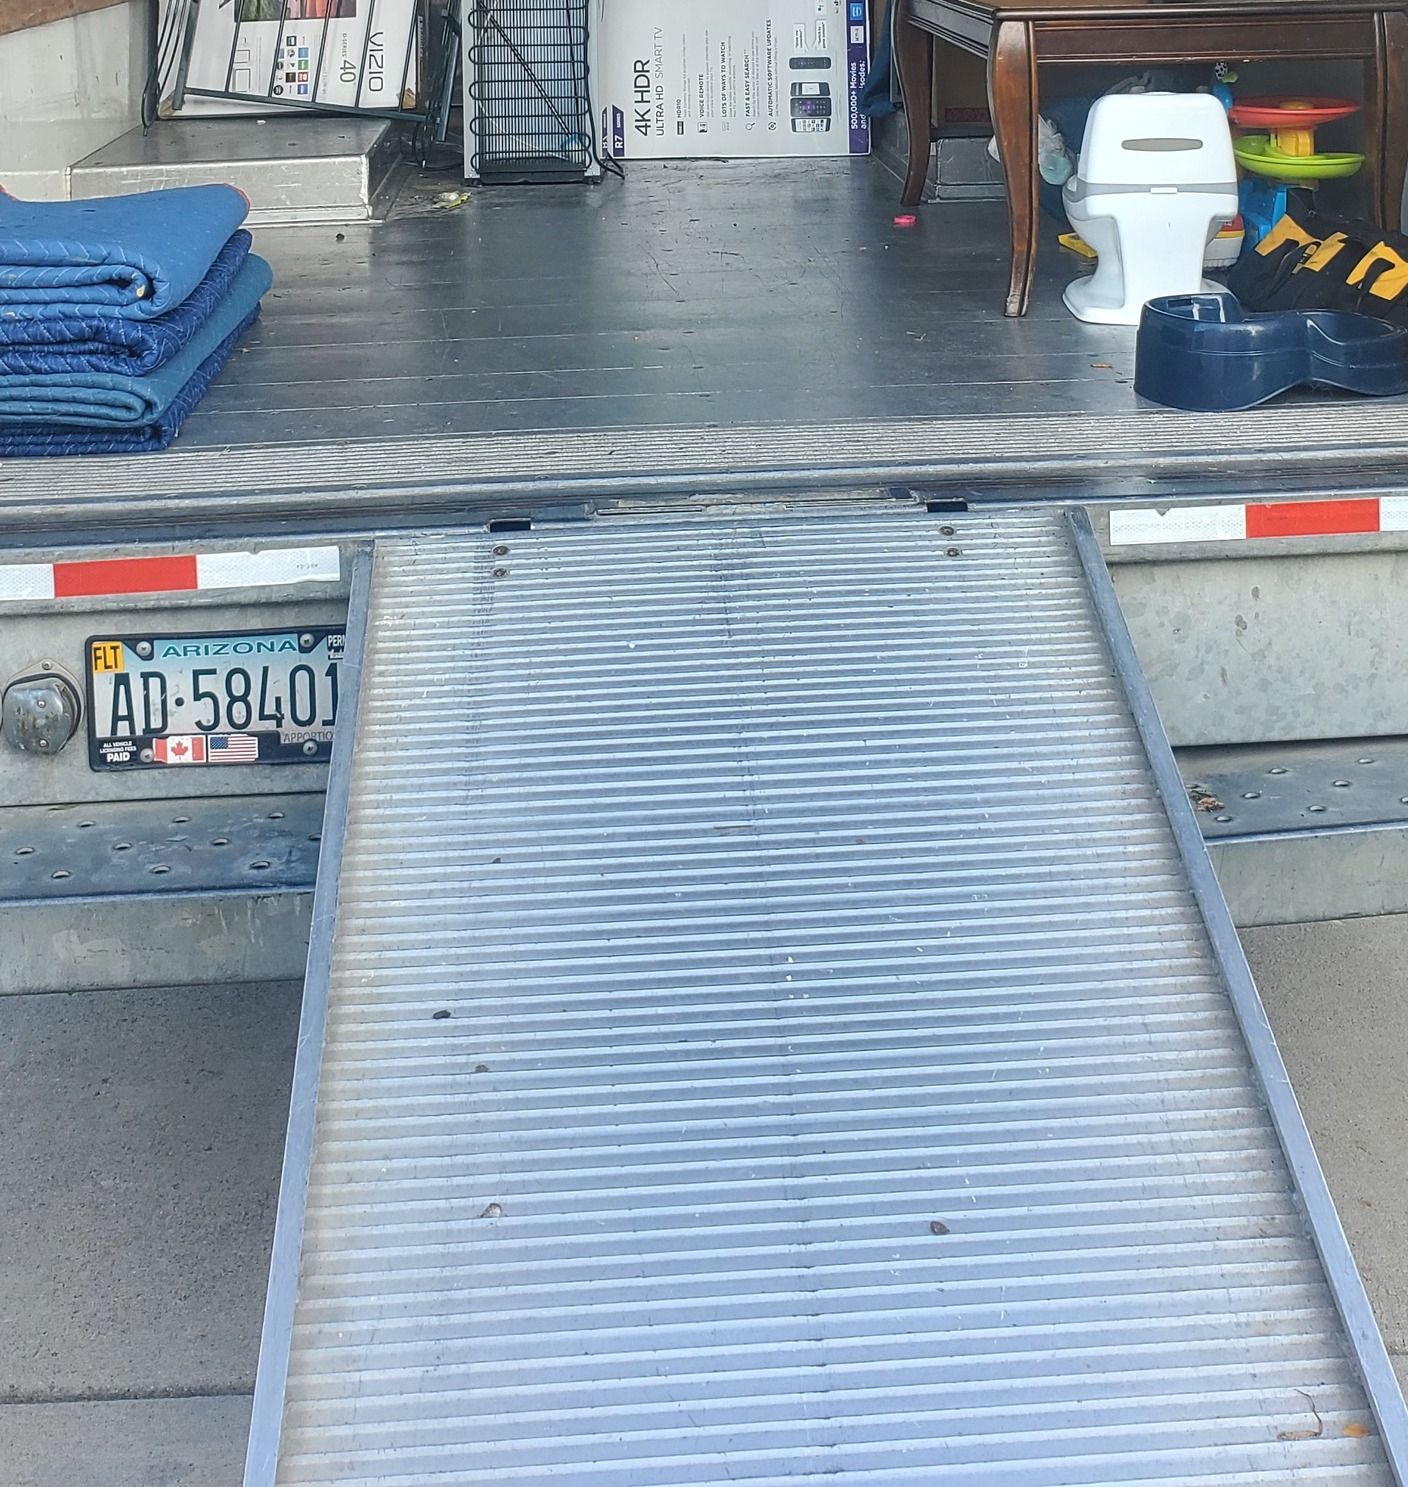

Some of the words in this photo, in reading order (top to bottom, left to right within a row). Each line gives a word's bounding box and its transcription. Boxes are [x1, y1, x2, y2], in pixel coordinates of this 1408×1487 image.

[653, 27, 663, 41] TV
[368, 32, 383, 92] VIZIO
[654, 43, 664, 79] SMART
[720, 64, 726, 73] TO
[633, 59, 650, 104] HDR
[655, 85, 663, 101] HD
[721, 93, 727, 101] OF
[655, 102, 664, 136] ULTRA
[850, 90, 858, 129] 500,000+
[634, 108, 651, 136] 4K
[859, 114, 867, 129] and
[614, 135, 623, 149] R7
[94, 645, 120, 670] FLT
[162, 639, 297, 658] ARIZONA
[107, 752, 130, 762] PAID
